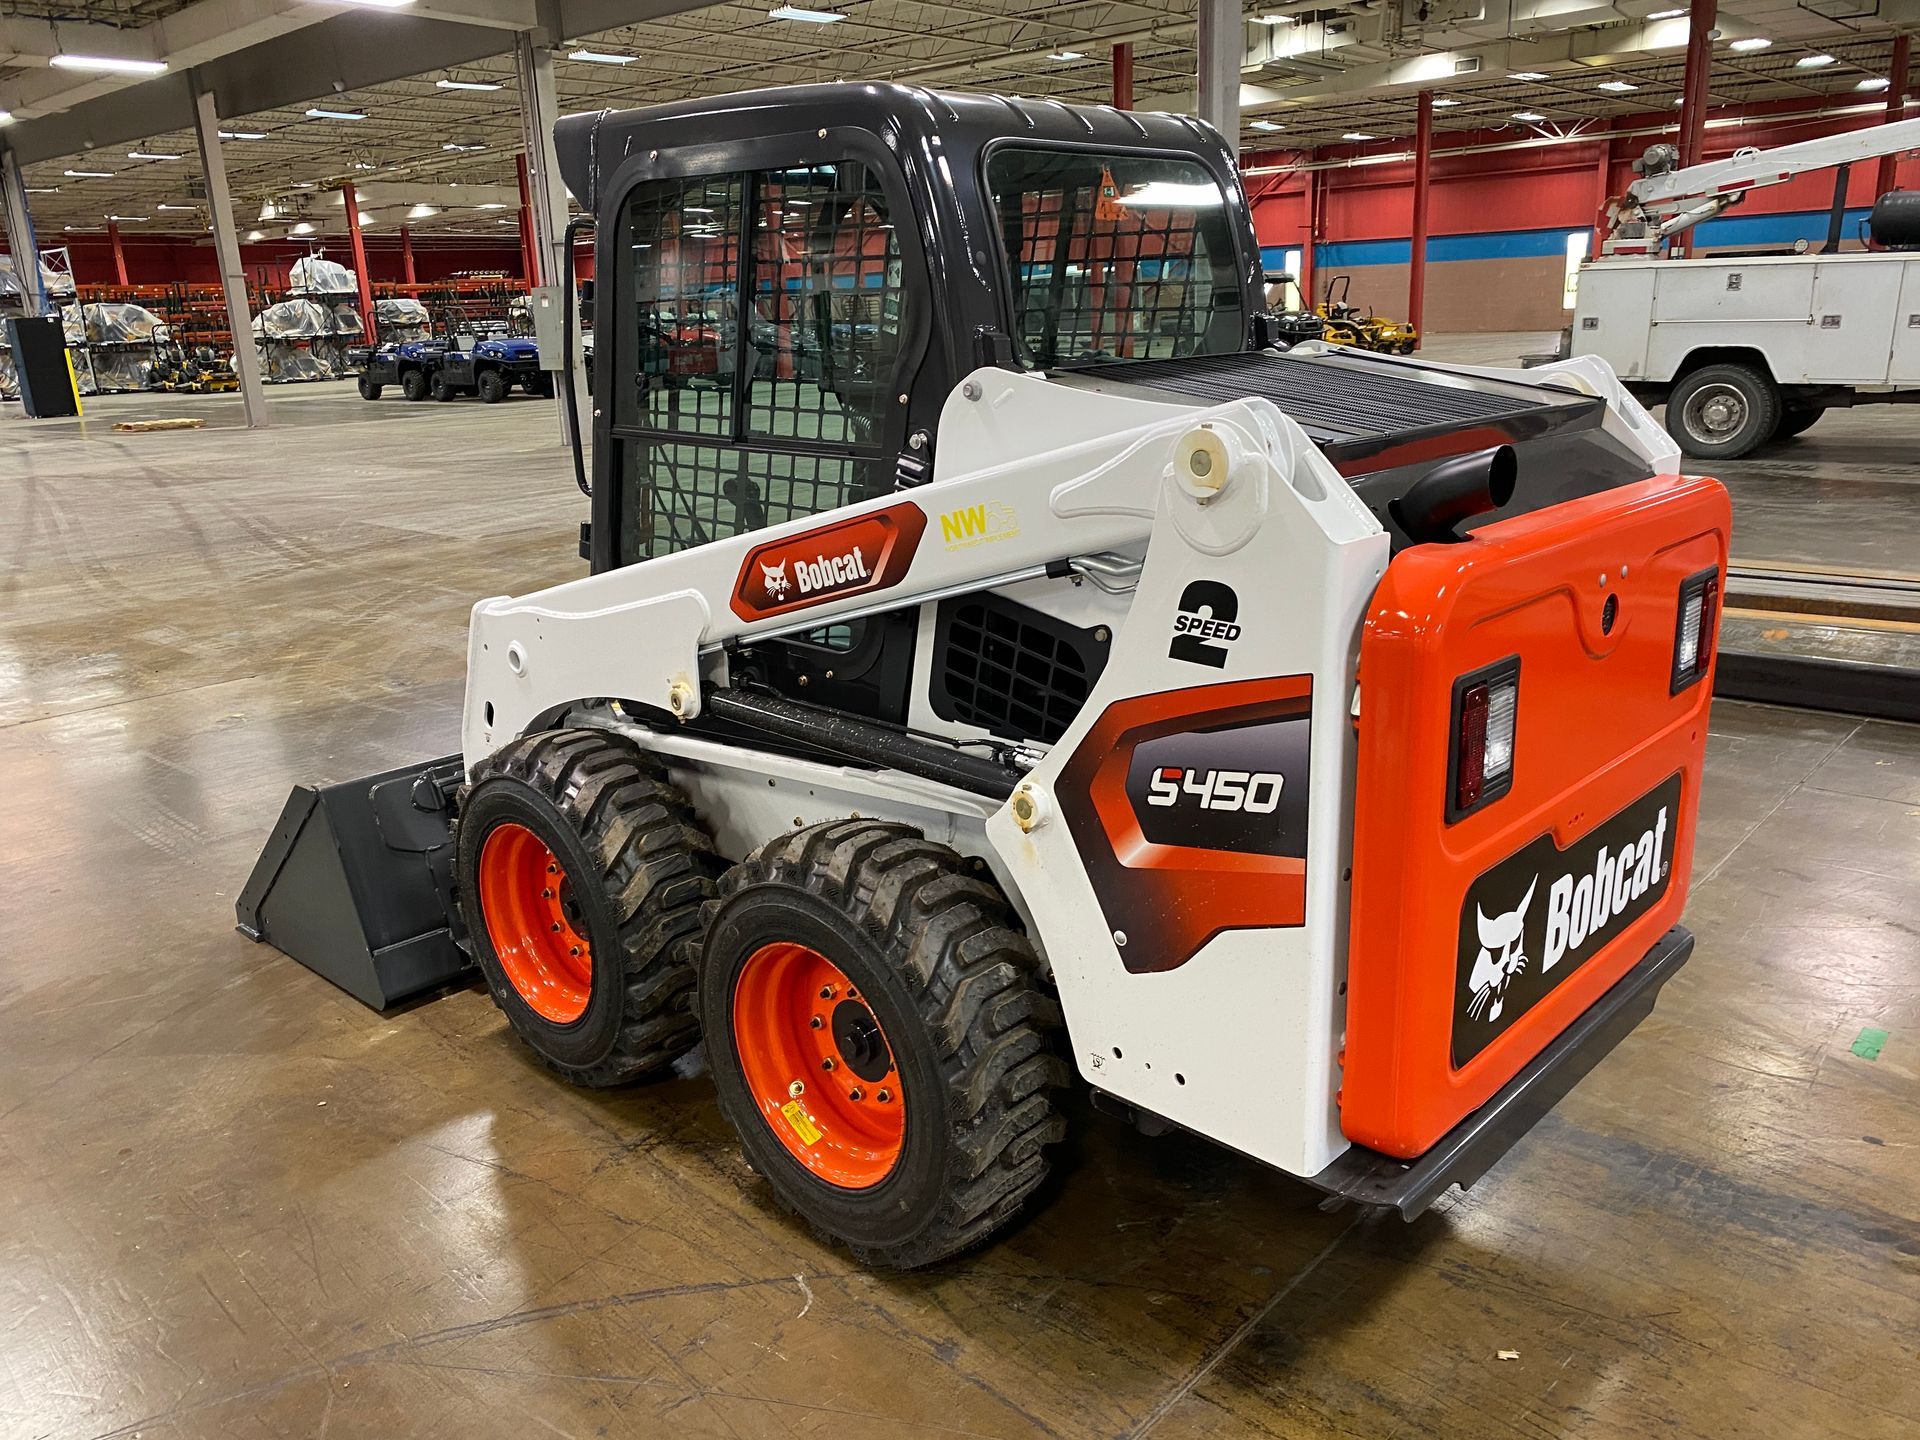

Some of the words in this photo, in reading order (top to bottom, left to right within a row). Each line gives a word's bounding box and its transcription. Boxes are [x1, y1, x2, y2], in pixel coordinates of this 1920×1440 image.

[940, 503, 986, 543] NW
[794, 546, 868, 593] Bobcat
[1168, 580, 1238, 669] 2
[1174, 615, 1241, 641] SPEED
[1147, 768, 1284, 814] S450
[1542, 806, 1667, 974] Bobcat
